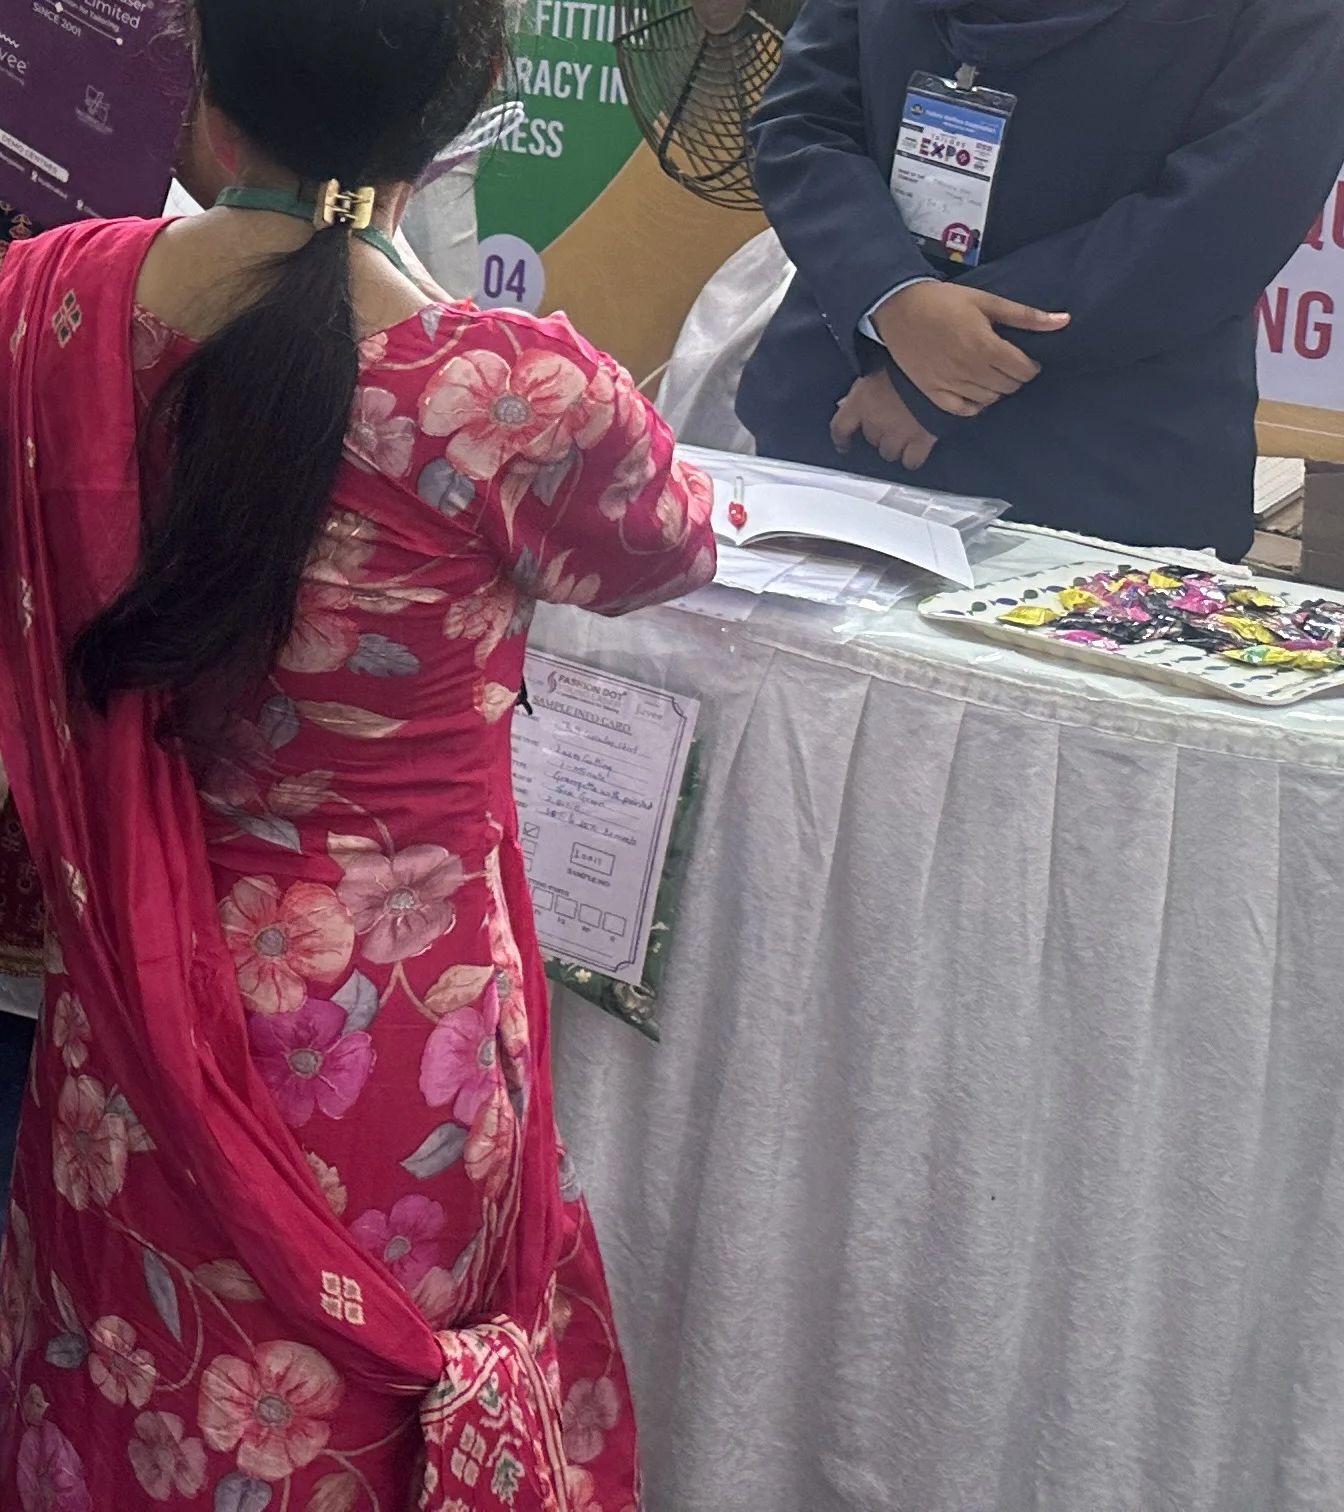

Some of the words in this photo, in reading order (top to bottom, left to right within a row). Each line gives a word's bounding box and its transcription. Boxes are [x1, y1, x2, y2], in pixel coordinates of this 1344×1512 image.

[483, 254, 526, 303] 04
[558, 674, 601, 695] FASHION
[602, 688, 624, 700] DOT
